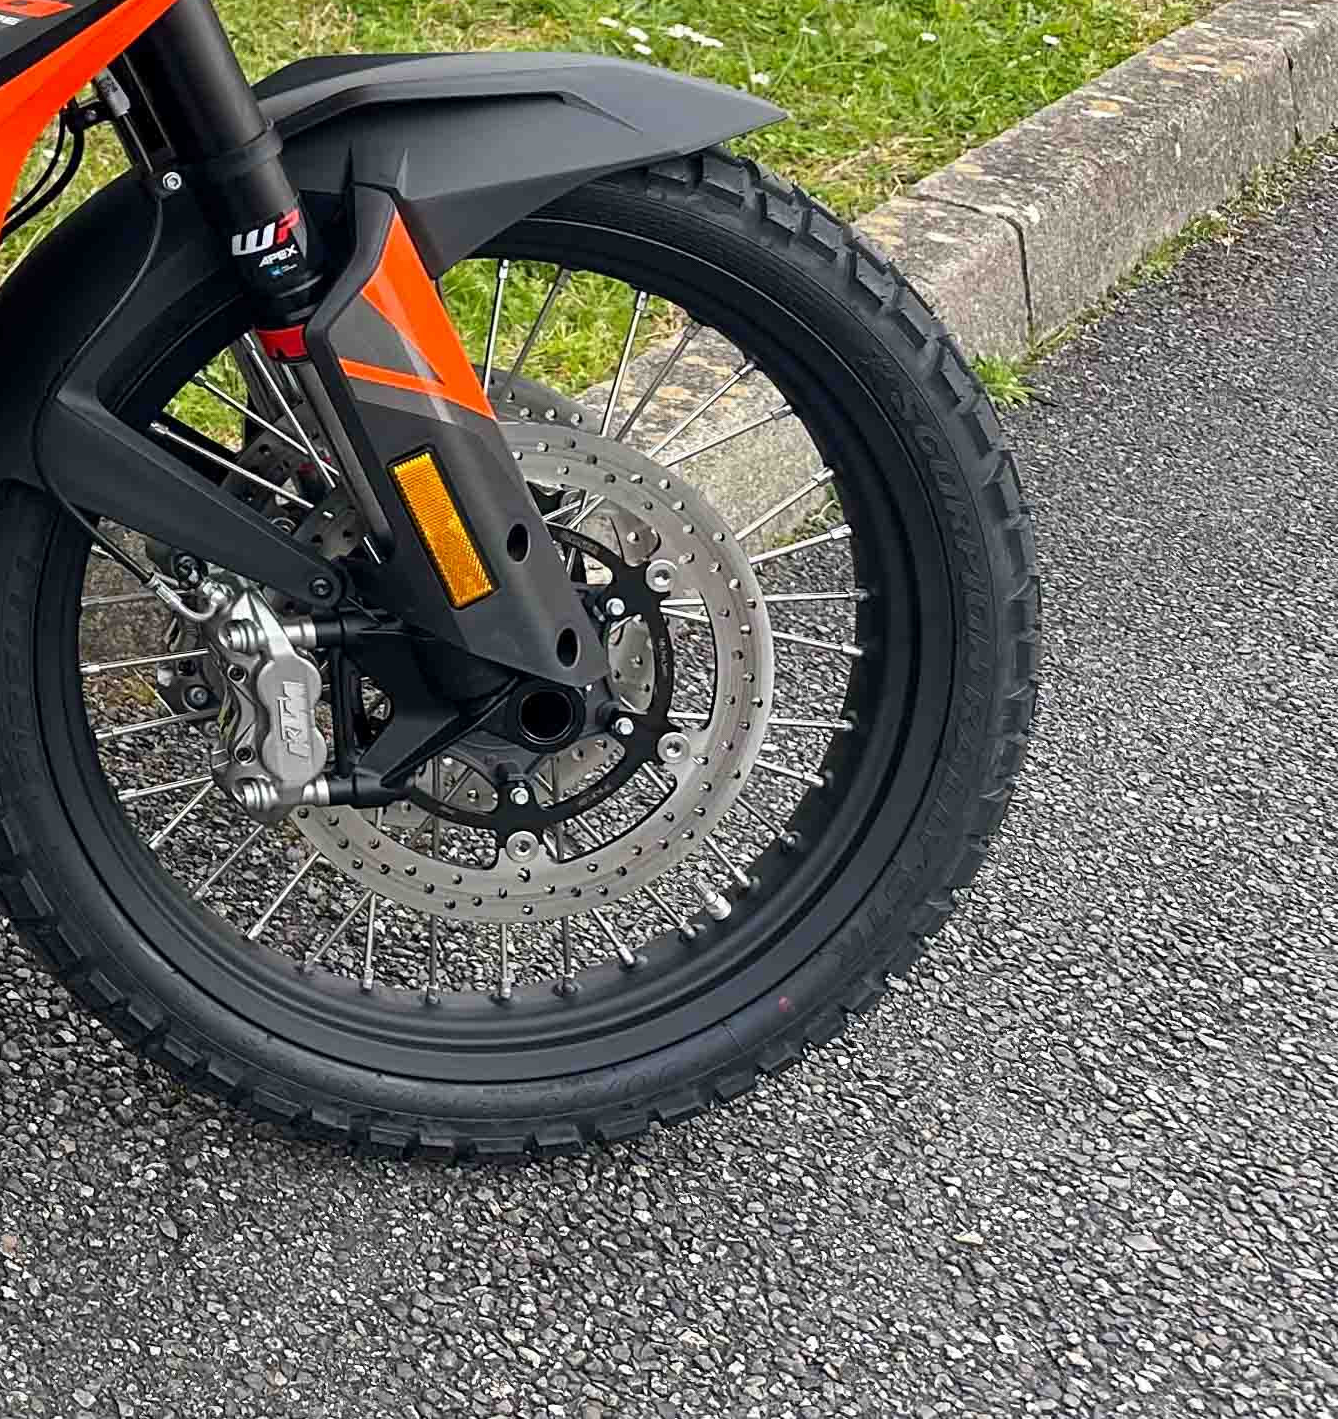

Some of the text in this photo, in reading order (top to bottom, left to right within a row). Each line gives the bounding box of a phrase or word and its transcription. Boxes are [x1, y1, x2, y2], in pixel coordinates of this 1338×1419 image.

[231, 209, 300, 256] WP
[259, 244, 299, 268] APEX
[276, 680, 310, 759] KTM
